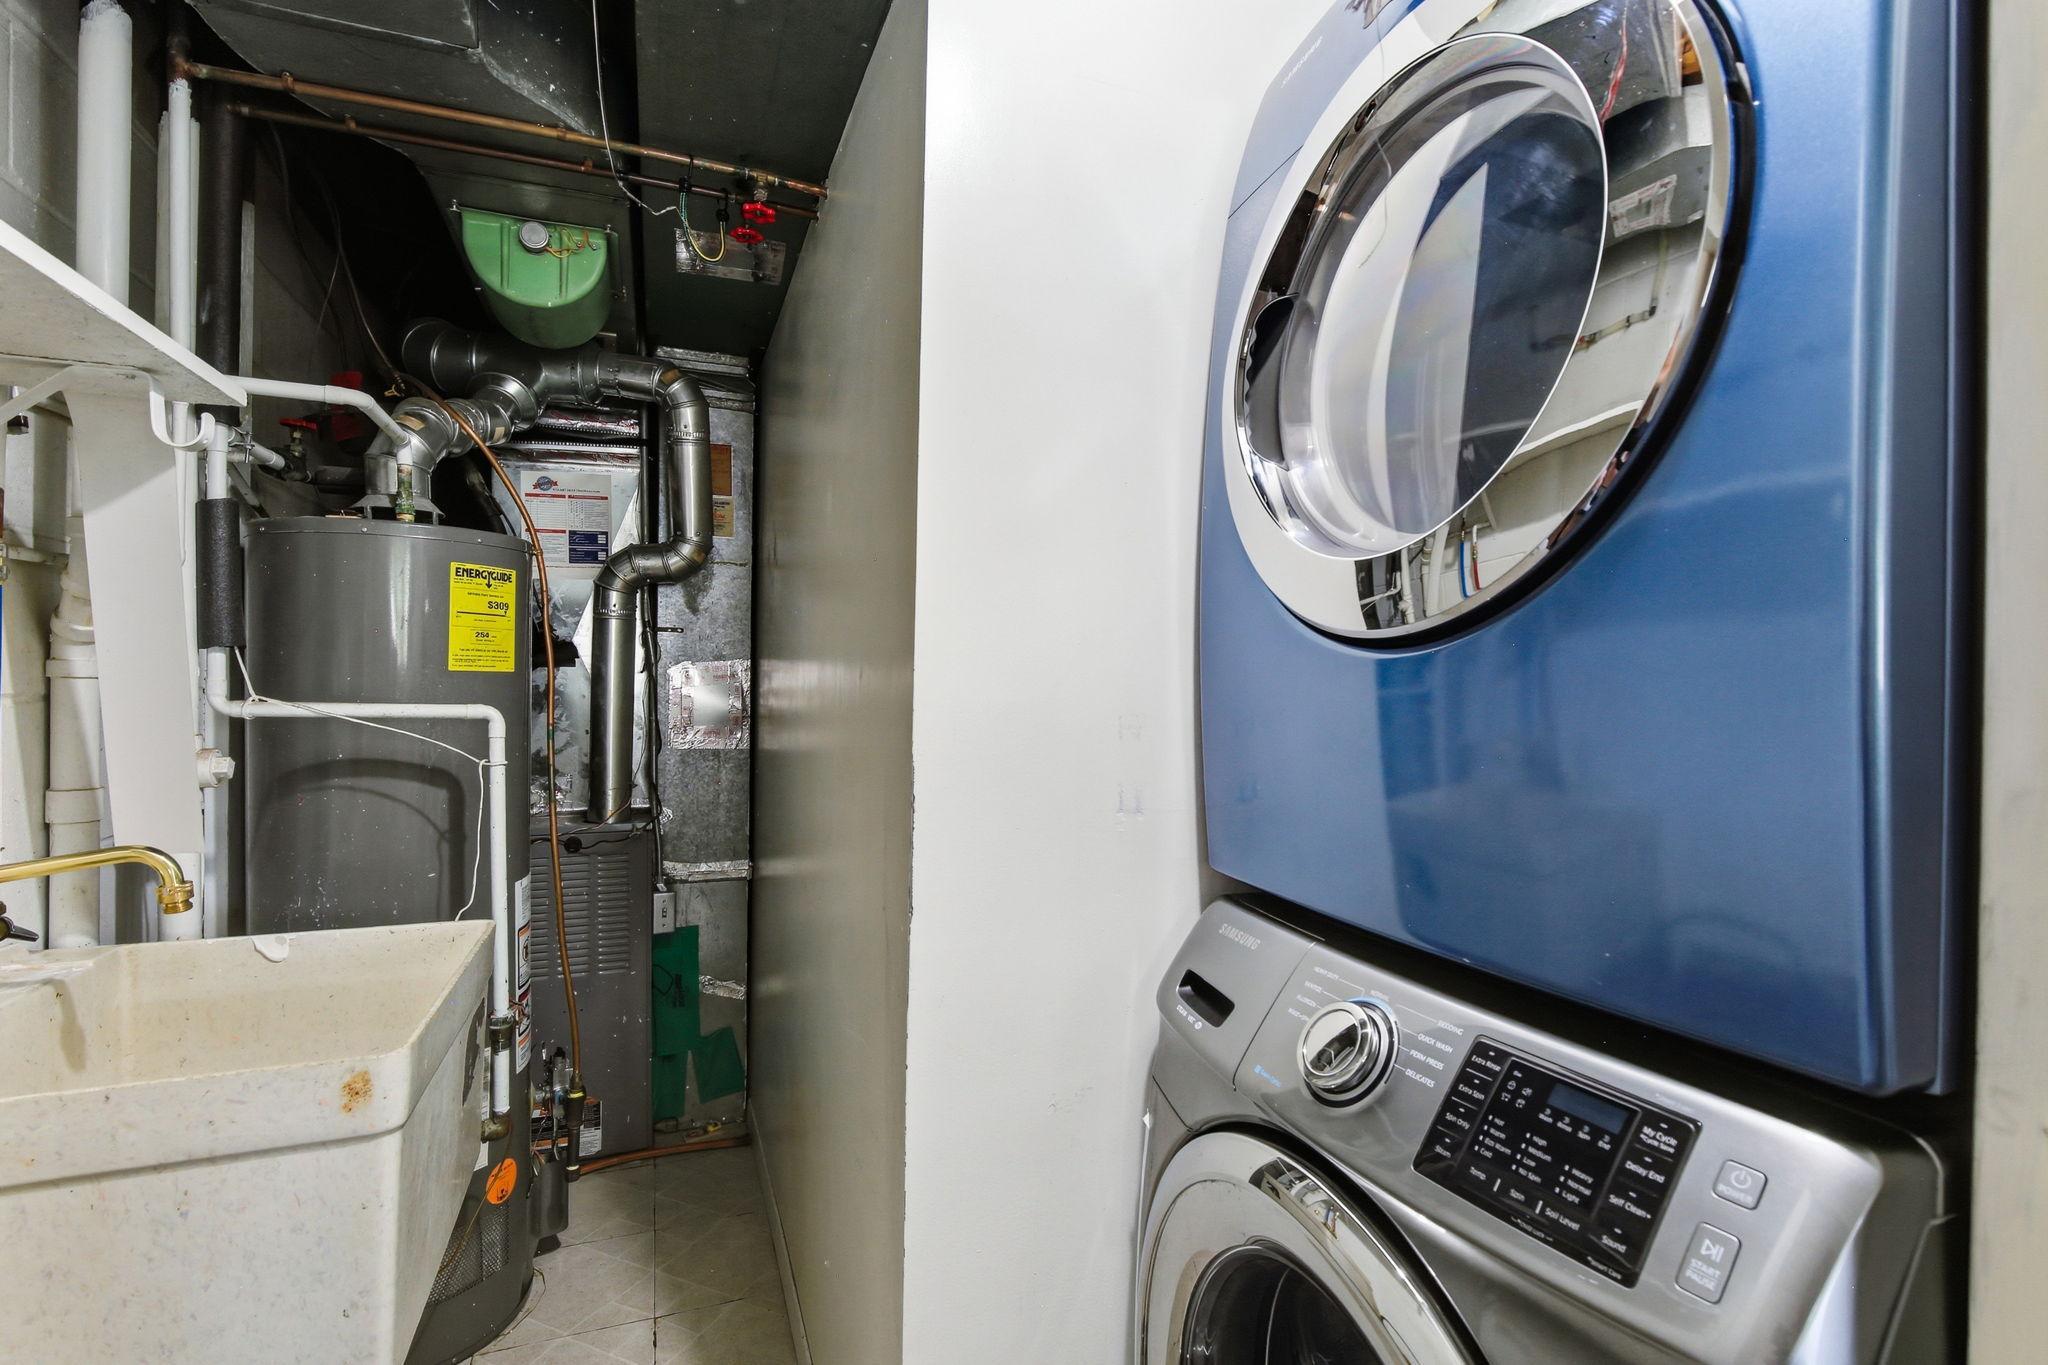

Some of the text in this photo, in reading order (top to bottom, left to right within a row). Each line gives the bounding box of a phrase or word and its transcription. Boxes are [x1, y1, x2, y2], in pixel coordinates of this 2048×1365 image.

[455, 566, 513, 583] ENERGYGUIDE
[1219, 923, 1261, 950] SAMSUNG
[1417, 1033, 1454, 1054] QUICK WASH
[1409, 1049, 1445, 1071] PERM PRESS
[1471, 1055, 1486, 1066] Extra
[1405, 1068, 1436, 1088] DELICATES
[1458, 1083, 1485, 1101] Extra Spin
[1445, 1112, 1471, 1130] Spin Only
[1642, 1125, 1678, 1147] My Cycle
[1624, 1160, 1666, 1184] Delay End
[1608, 1194, 1625, 1207] Self
[1558, 1215, 1581, 1232] Level
[1601, 1234, 1627, 1254] Sound
[1690, 1258, 1722, 1279] START
